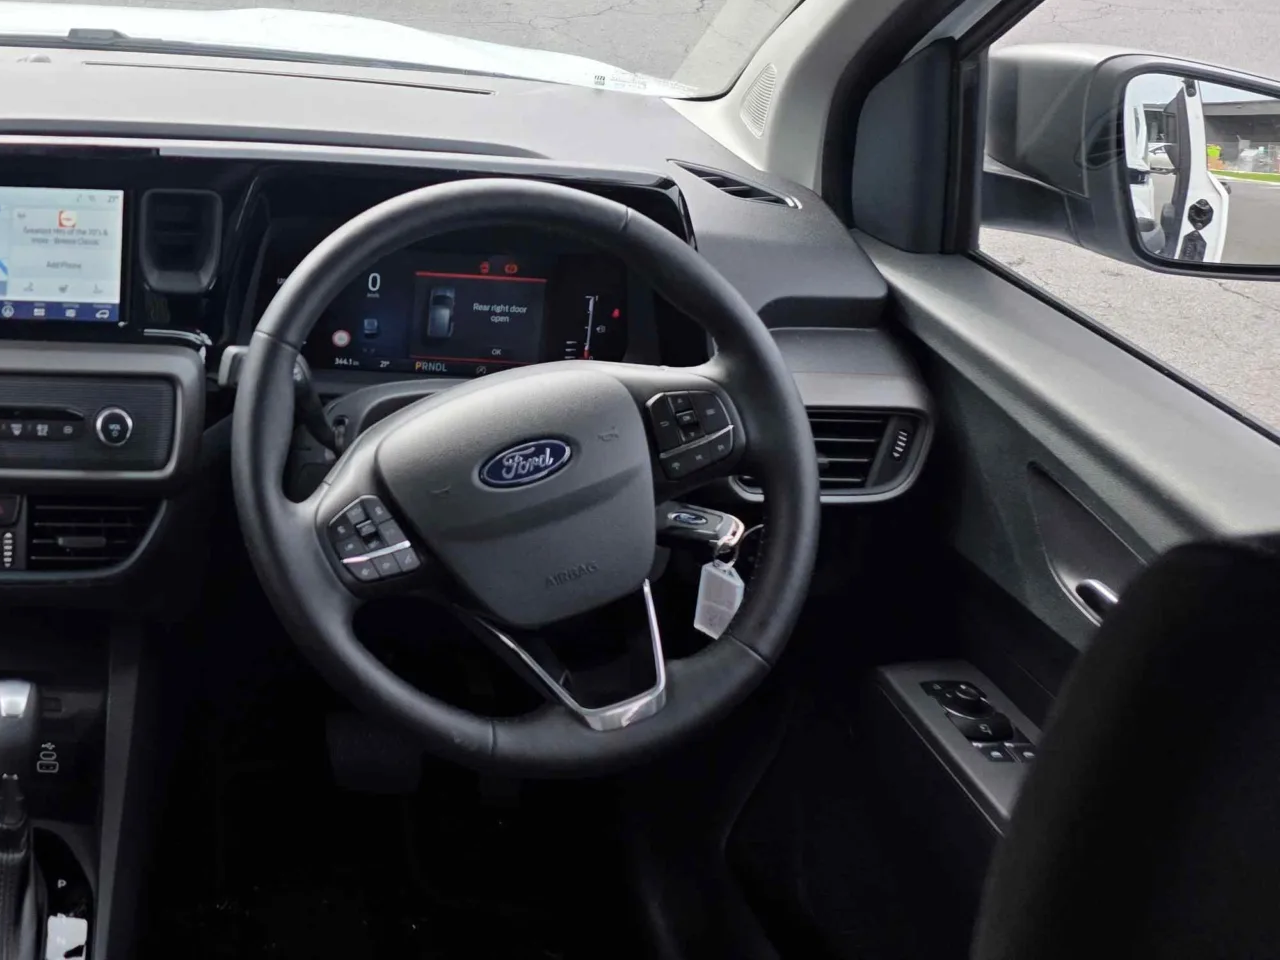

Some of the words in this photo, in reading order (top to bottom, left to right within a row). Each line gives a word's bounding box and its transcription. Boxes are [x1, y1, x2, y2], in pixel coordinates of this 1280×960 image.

[368, 272, 381, 291] 0
[473, 302, 490, 311] Rear
[491, 304, 509, 313] right
[510, 305, 527, 313] door
[490, 315, 510, 323] open
[501, 446, 554, 479] Ford
[545, 561, 599, 588] AIRBAG
[57, 879, 67, 888] P
